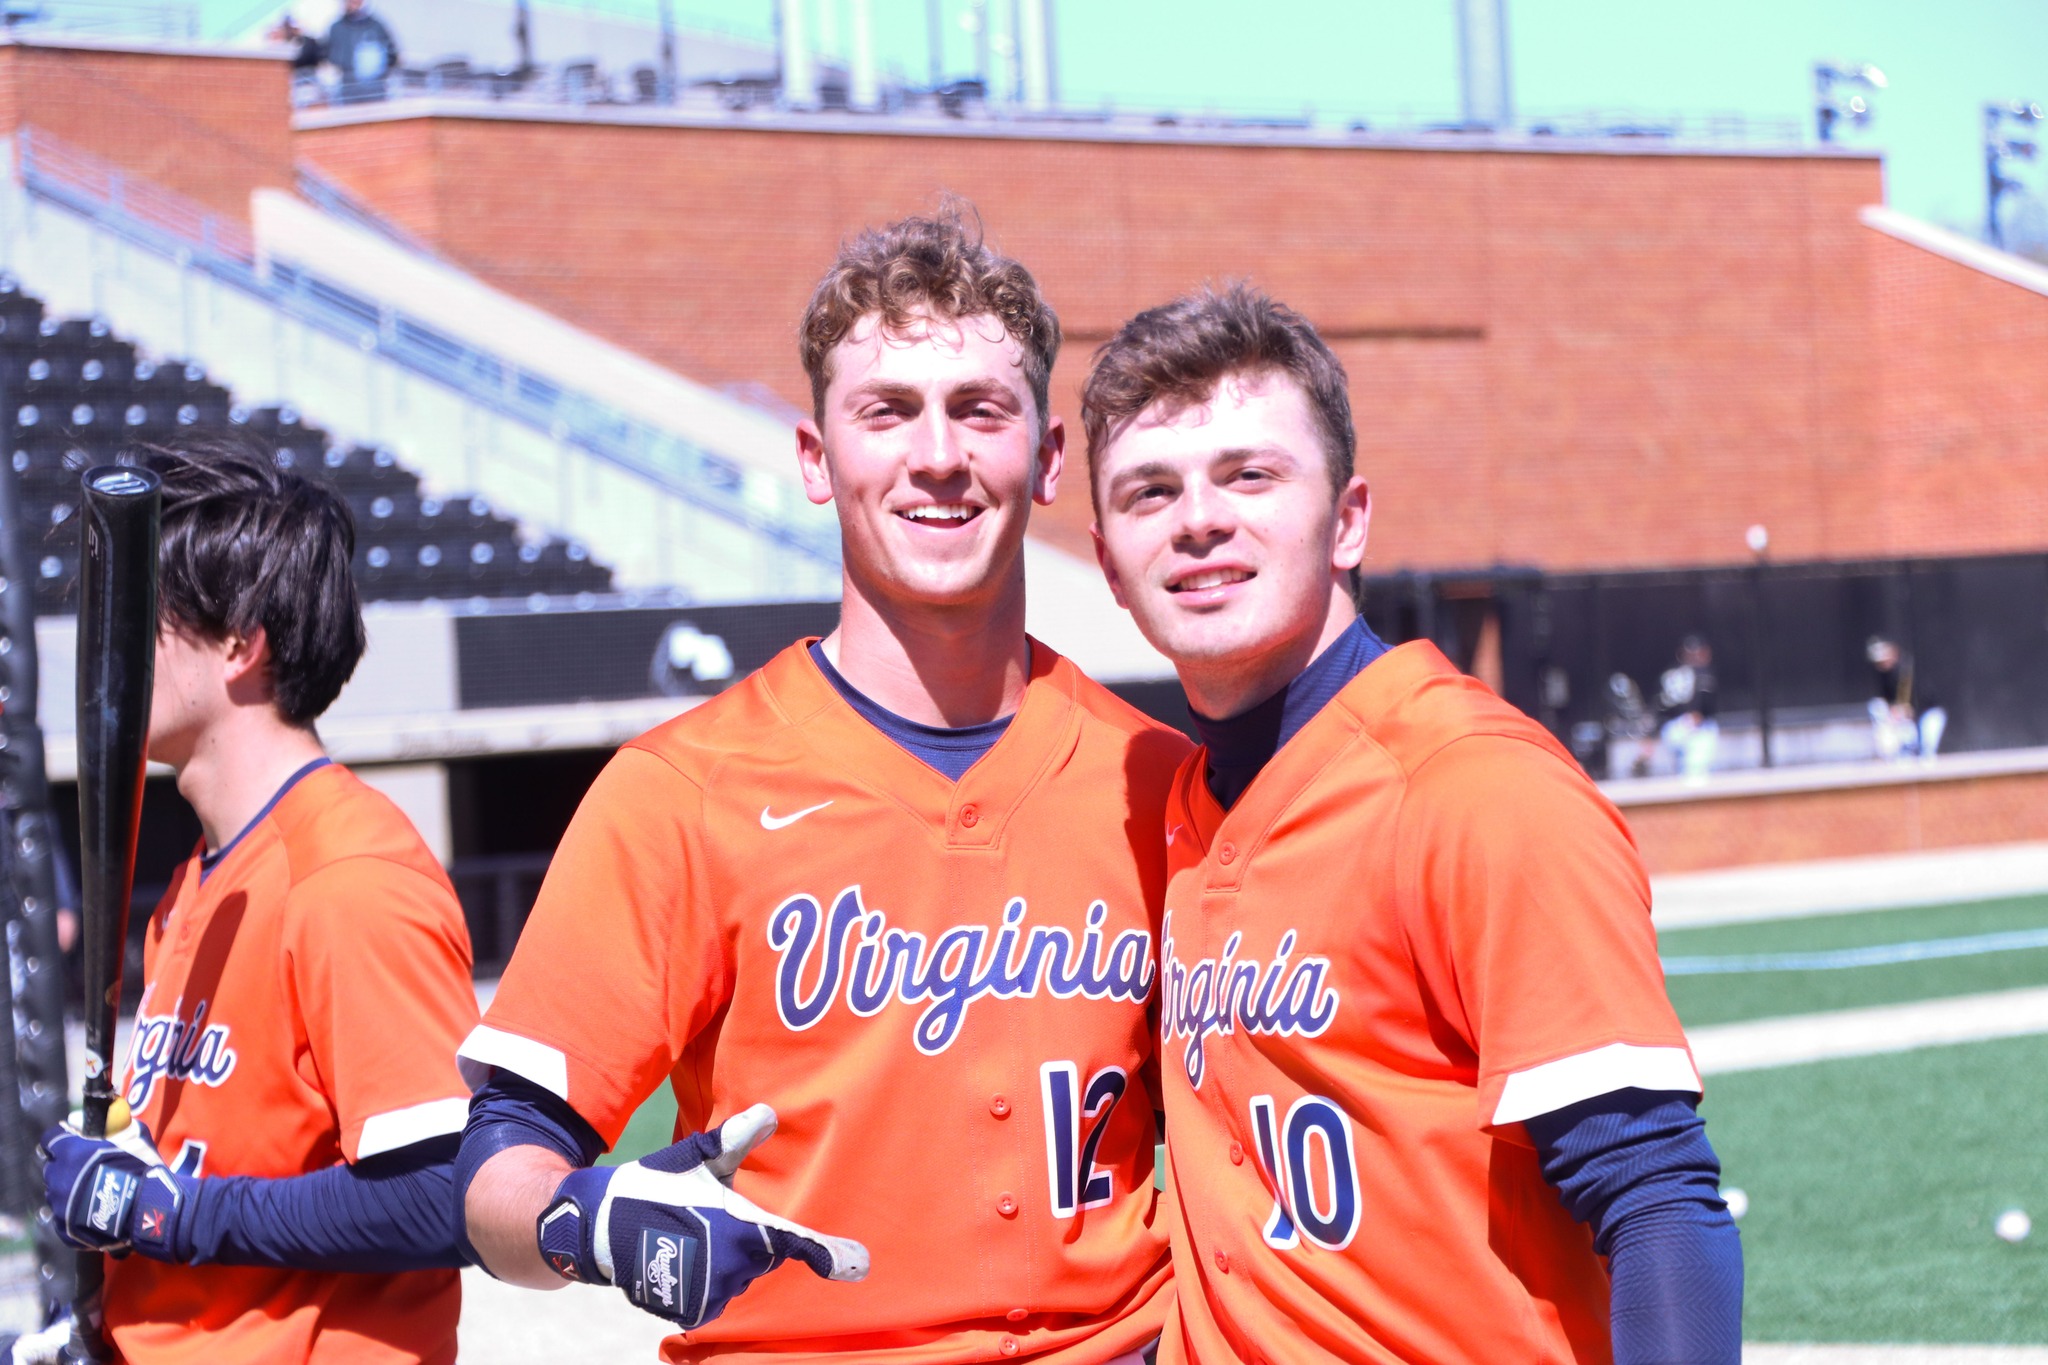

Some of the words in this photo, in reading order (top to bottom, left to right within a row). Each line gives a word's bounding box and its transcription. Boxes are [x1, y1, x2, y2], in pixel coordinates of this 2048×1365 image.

[767, 884, 1156, 1056] Virginia
[1161, 910, 1339, 1091] irginia
[1039, 1060, 1130, 1218] 12
[1250, 1094, 1362, 1251] 10
[652, 1236, 678, 1307] Rawlings
